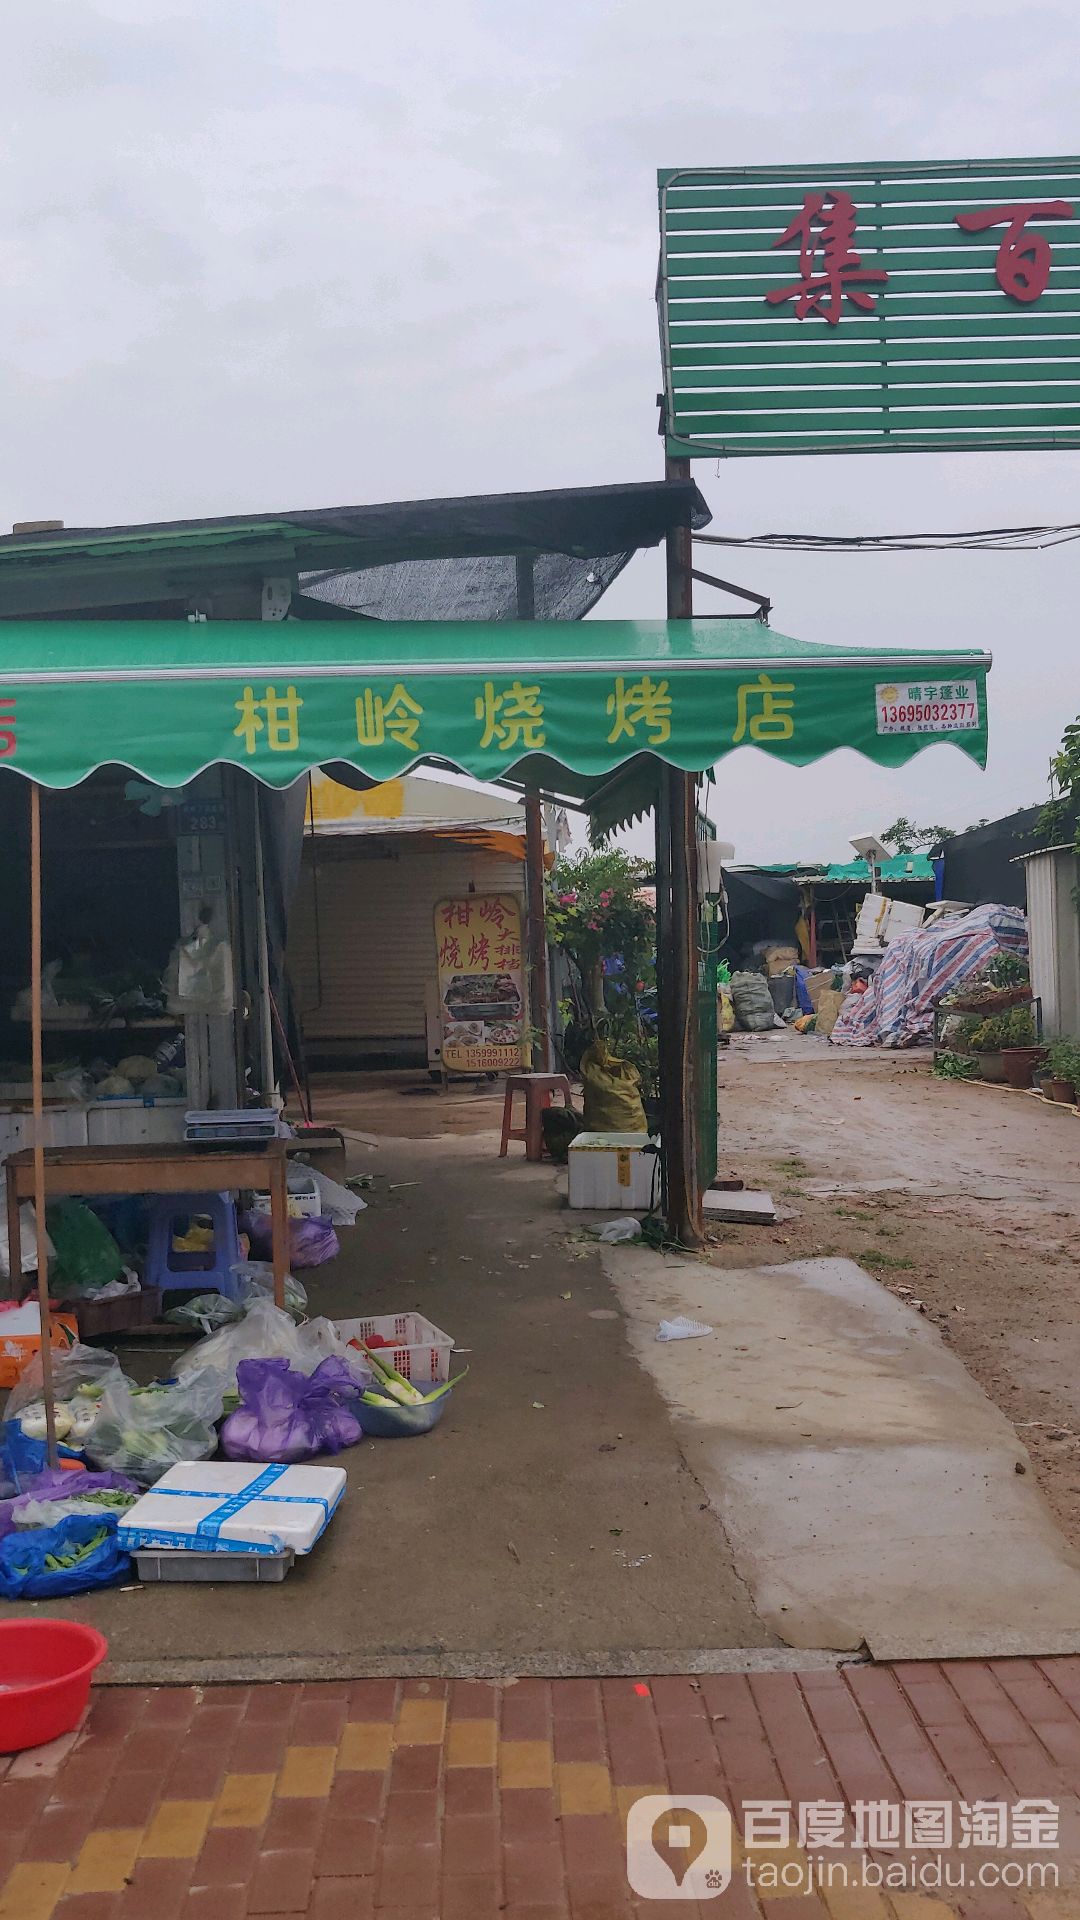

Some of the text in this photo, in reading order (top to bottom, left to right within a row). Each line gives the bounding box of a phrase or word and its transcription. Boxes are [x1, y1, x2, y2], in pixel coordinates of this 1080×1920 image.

[233, 673, 796, 755] 柑岭烧烤店
[881, 703, 975, 722] 13695032377
[440, 897, 517, 930] 柑岭
[439, 933, 491, 971] 烧烤
[444, 1049, 462, 1060] TEL
